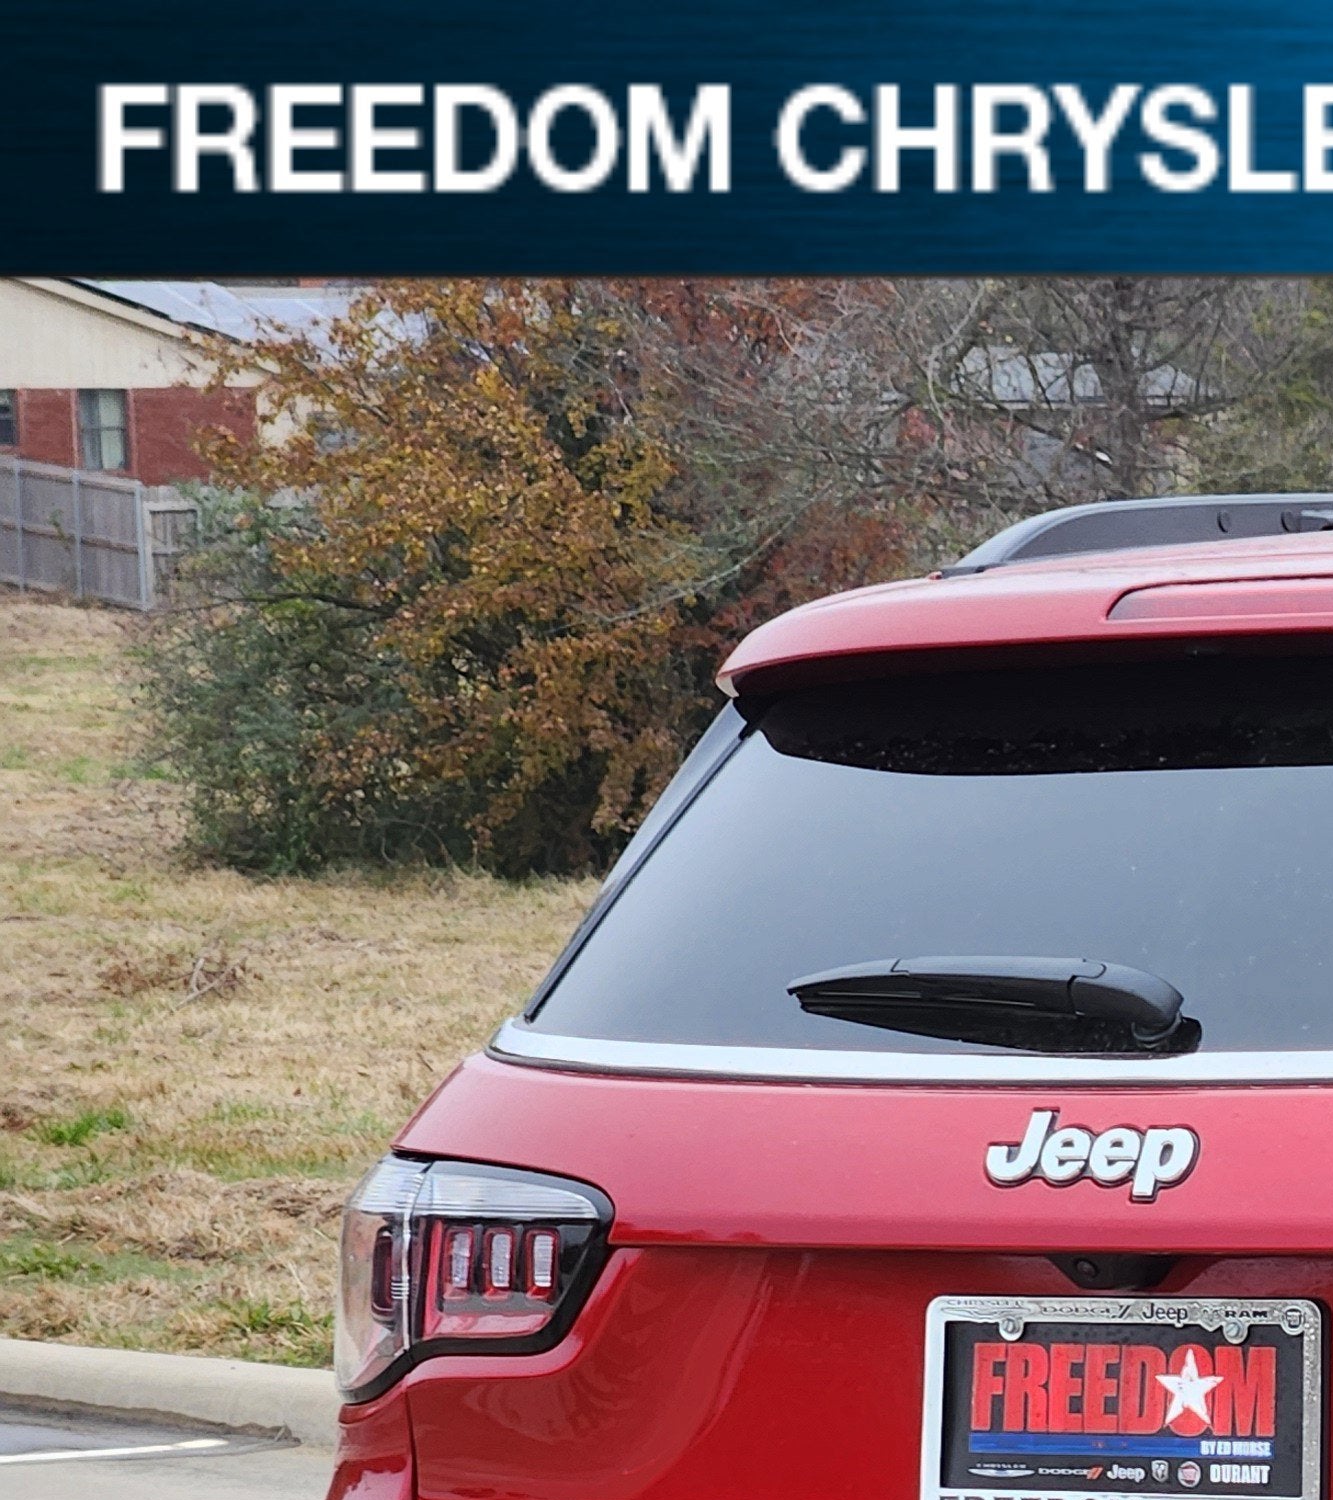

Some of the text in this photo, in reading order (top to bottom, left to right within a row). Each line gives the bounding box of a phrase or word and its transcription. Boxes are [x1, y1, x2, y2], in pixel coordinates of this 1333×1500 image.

[985, 1108, 1198, 1201] Jeep
[1142, 1302, 1189, 1322] Jeep
[1224, 1310, 1268, 1318] RAM
[970, 1341, 1277, 1437] FREEDOM
[1106, 1464, 1146, 1483] Jeep
[1209, 1463, 1271, 1484] DURANT
